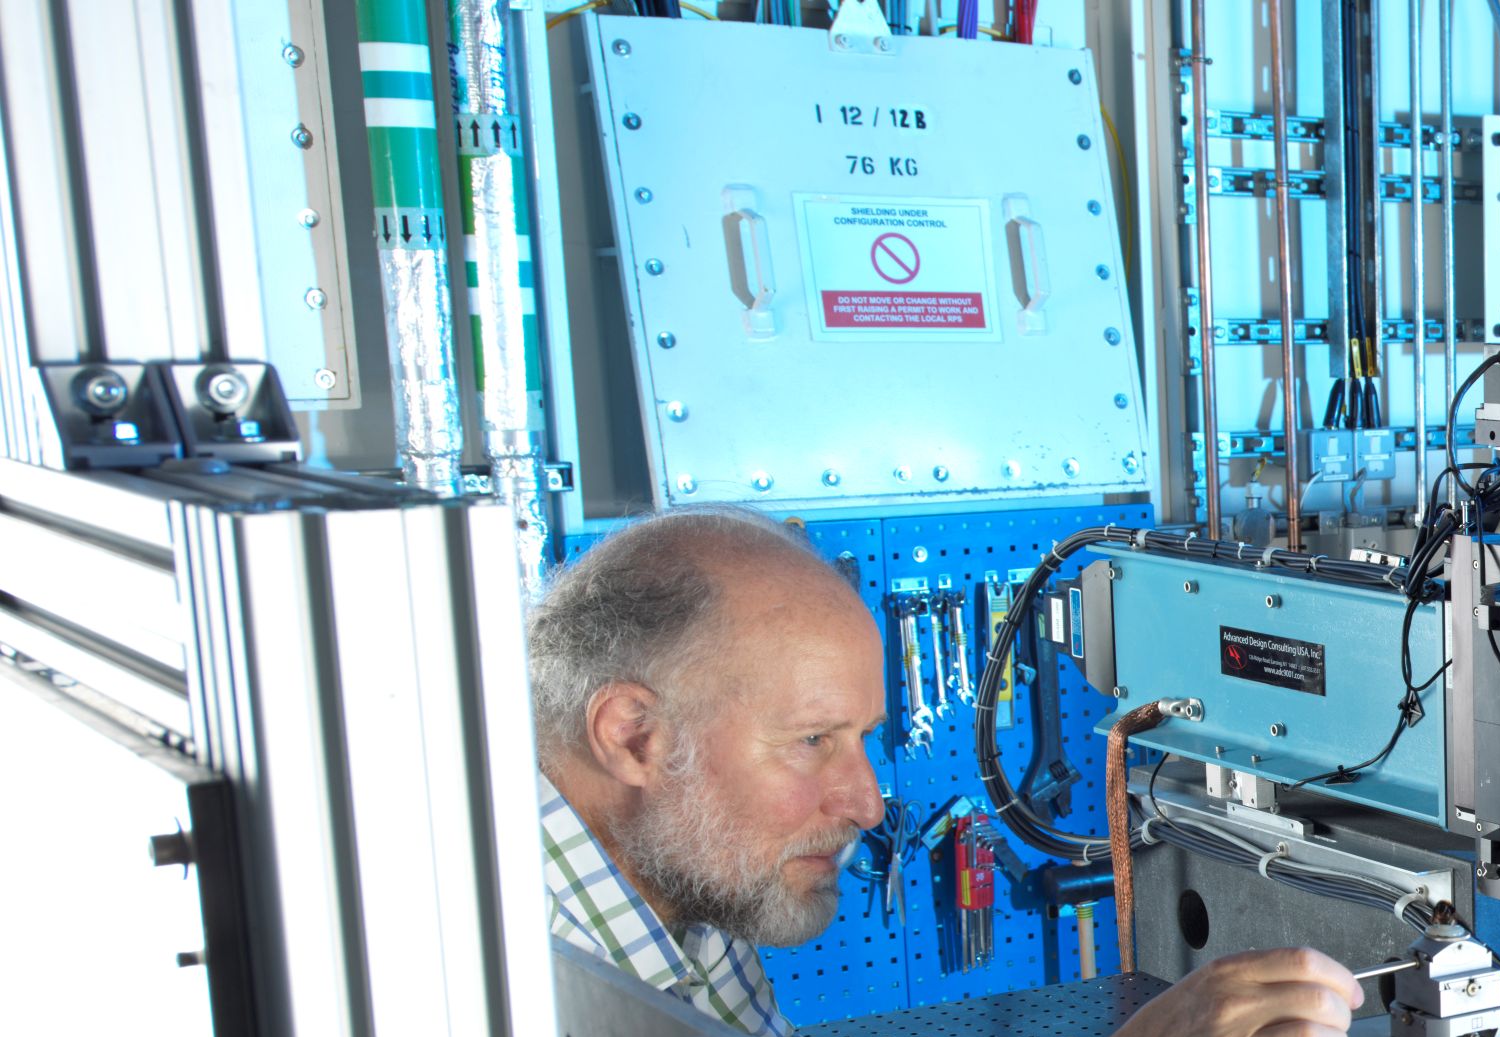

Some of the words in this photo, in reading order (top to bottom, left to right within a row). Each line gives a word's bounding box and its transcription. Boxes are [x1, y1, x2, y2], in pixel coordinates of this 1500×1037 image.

[840, 105, 863, 125] 12
[846, 155, 875, 175] 76
[889, 157, 918, 176] KG
[851, 207, 897, 216] SHIELDING
[898, 209, 929, 217] UNDER
[834, 217, 904, 227] CONFIGURATION
[906, 219, 948, 228] CONTROL
[838, 296, 850, 304] DO
[869, 297, 892, 305] MOVE
[893, 297, 905, 305] OR
[906, 297, 937, 305] CHANGE
[833, 305, 856, 313] FIRST
[938, 306, 961, 314] WORK
[921, 315, 947, 323] LOCAL
[947, 315, 963, 323] RPS
[1223, 631, 1249, 645] Advanced
[1249, 636, 1267, 650] Design
[1267, 640, 1297, 657] Consulting
[1296, 646, 1310, 658] USA,
[1310, 649, 1321, 659] Inc.
